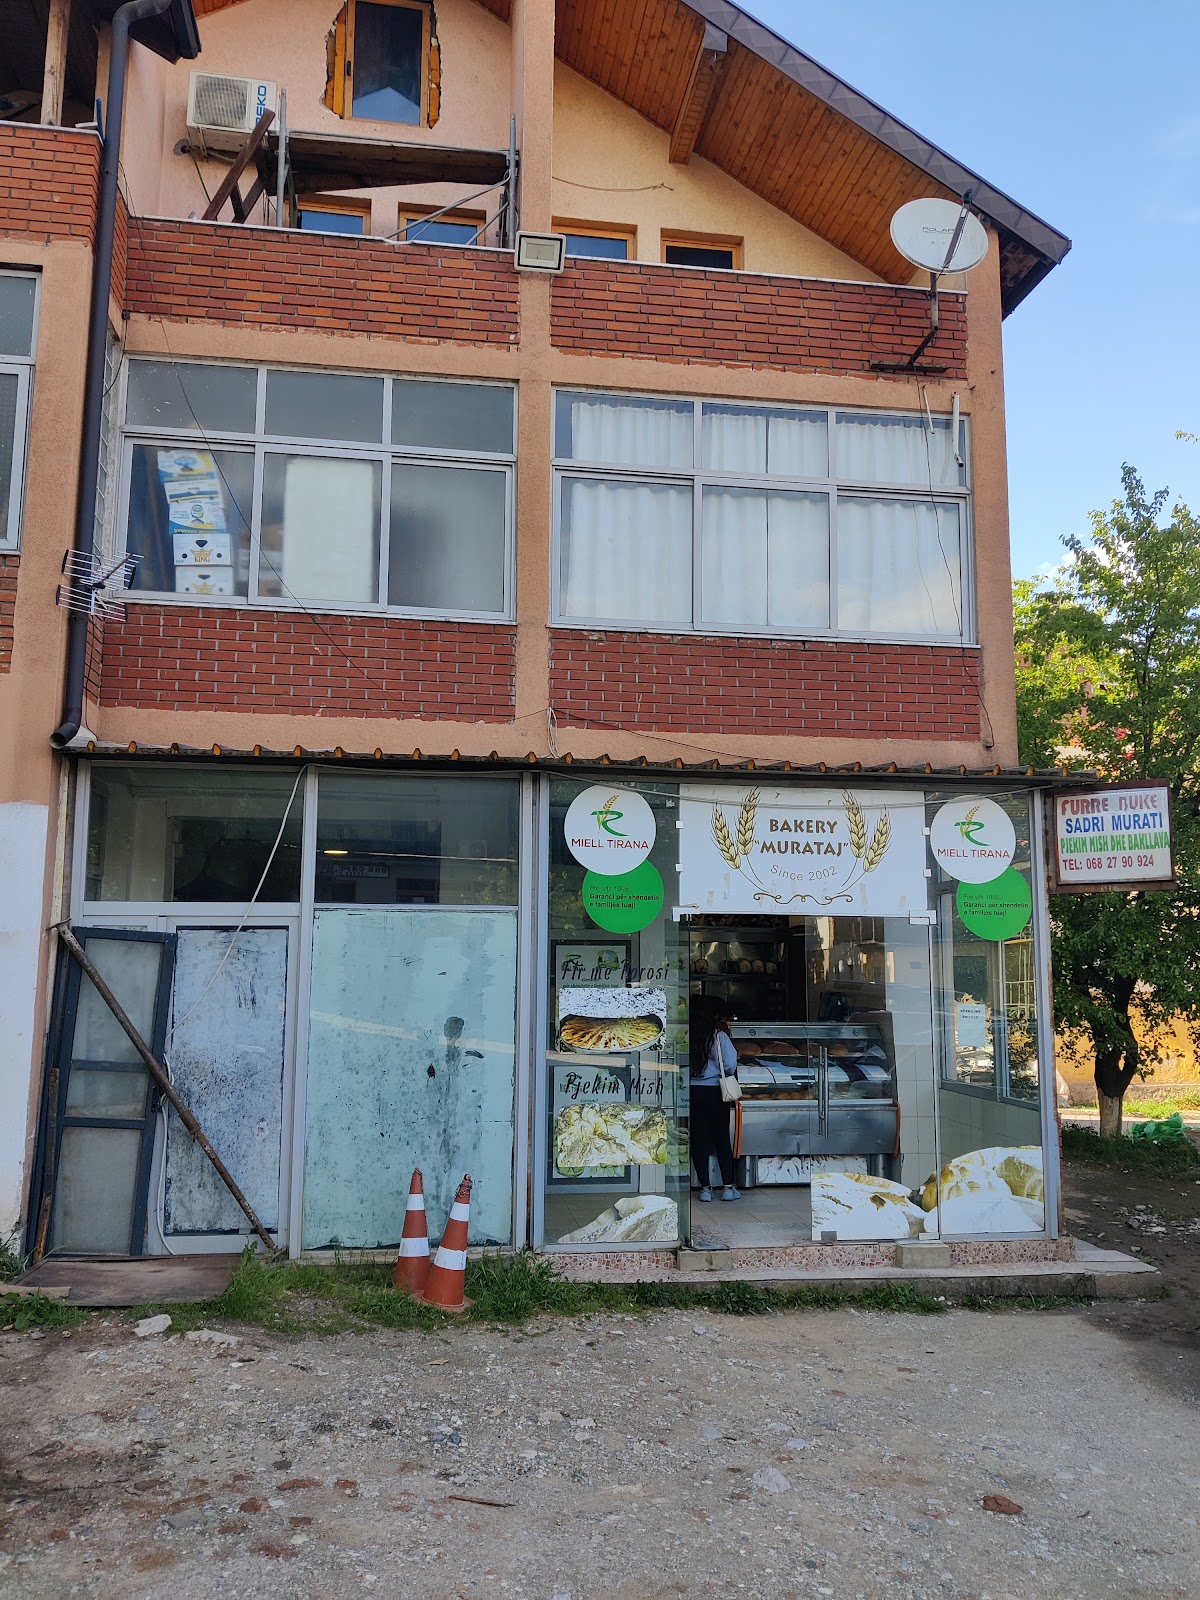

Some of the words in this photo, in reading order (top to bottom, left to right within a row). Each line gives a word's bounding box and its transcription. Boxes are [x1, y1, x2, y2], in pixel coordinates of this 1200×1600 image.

[1061, 798, 1109, 816] FURRE
[1119, 794, 1158, 812] BUKE
[769, 818, 838, 834] BAKERY
[1065, 816, 1104, 834] SADRI
[1111, 812, 1163, 831] MURATI
[571, 838, 604, 849] MIELL
[606, 839, 649, 850] TIRANA
[754, 840, 850, 857] "MURATAJ"
[1060, 836, 1088, 854] PJEKIM
[1089, 835, 1109, 853] MISH
[1110, 834, 1126, 851] DHE
[1128, 831, 1170, 850] BAKLLAVA
[937, 848, 968, 858] MIELL
[971, 849, 1010, 858] TIRANA
[1062, 858, 1083, 871] TEL:
[1086, 857, 1103, 870] 068
[1107, 856, 1117, 869] 27
[1121, 855, 1133, 868] 90
[1137, 854, 1155, 867] 924
[770, 864, 804, 881] Since
[808, 865, 838, 881] 2002
[590, 967, 612, 980] me
[565, 1071, 620, 1100] Pjekim
[629, 1074, 664, 1096] Mish
